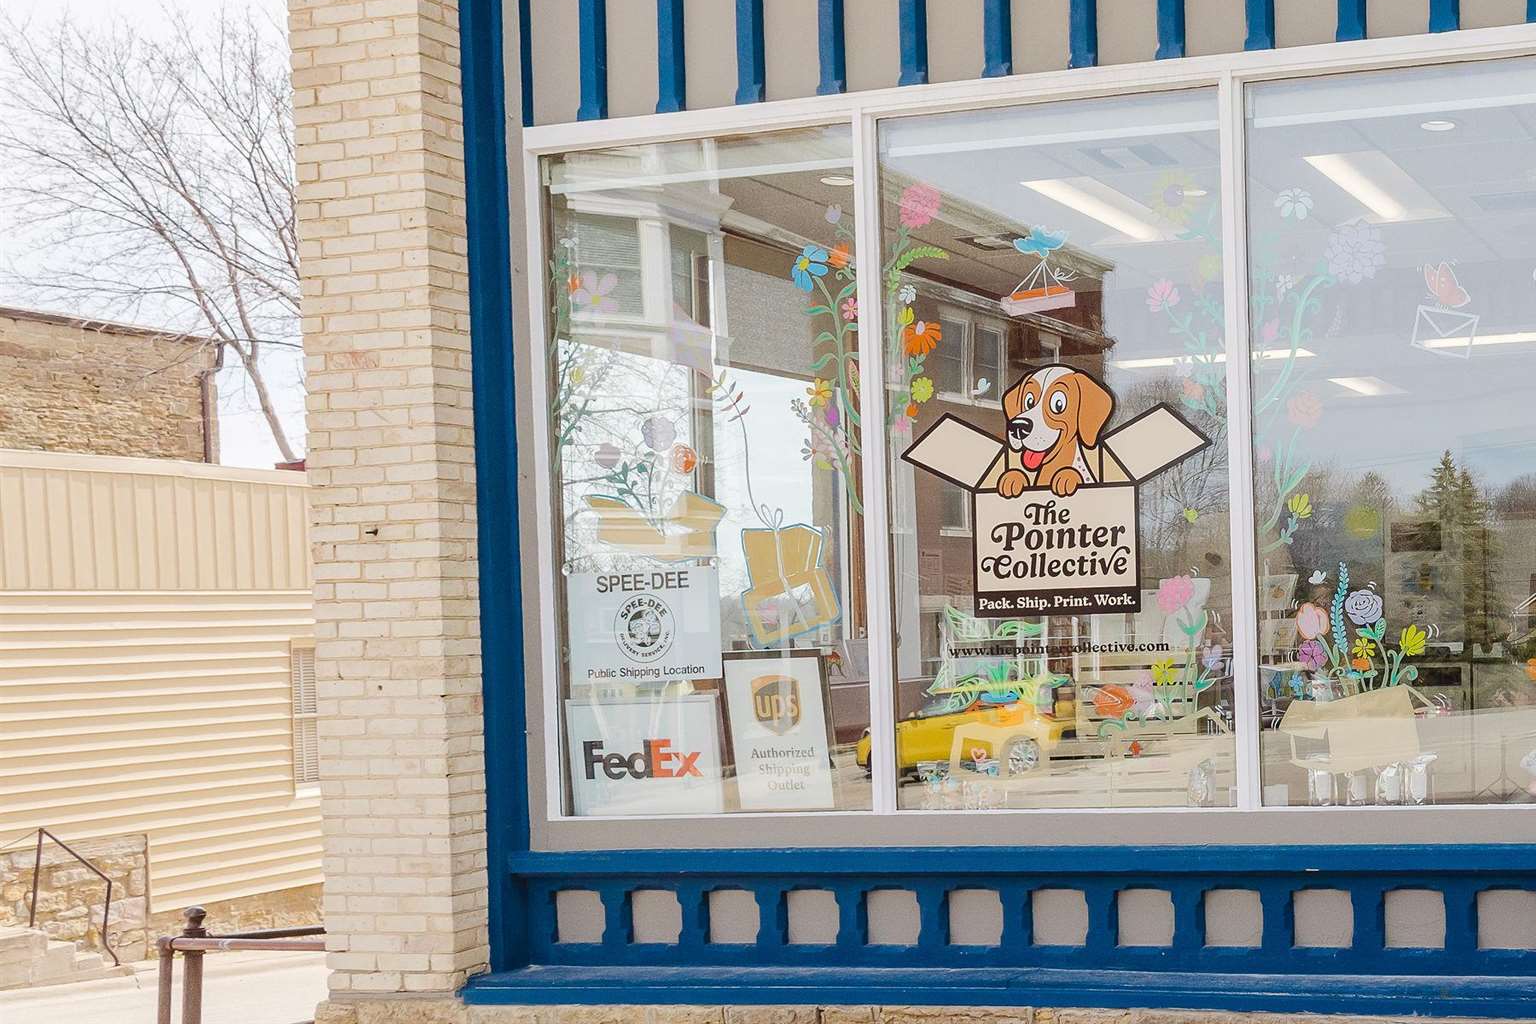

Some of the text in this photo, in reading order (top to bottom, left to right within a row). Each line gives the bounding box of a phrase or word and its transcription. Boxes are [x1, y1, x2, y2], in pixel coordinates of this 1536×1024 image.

[1023, 500, 1070, 526] The
[990, 522, 1126, 552] Pointer
[980, 545, 1131, 579] Collective
[596, 571, 690, 593] SPEE-DEE
[620, 598, 668, 620] SPEE-DEE
[978, 593, 1136, 611] Pack. Ship. Print. Work.
[949, 641, 1170, 659] www.thepointercollective.com
[587, 664, 705, 680] Public Shipping Location
[753, 694, 800, 727] ups
[583, 738, 704, 780] FedEx
[750, 746, 816, 760] Authorized
[758, 764, 810, 778] Shipping
[767, 780, 806, 792] Outlet
